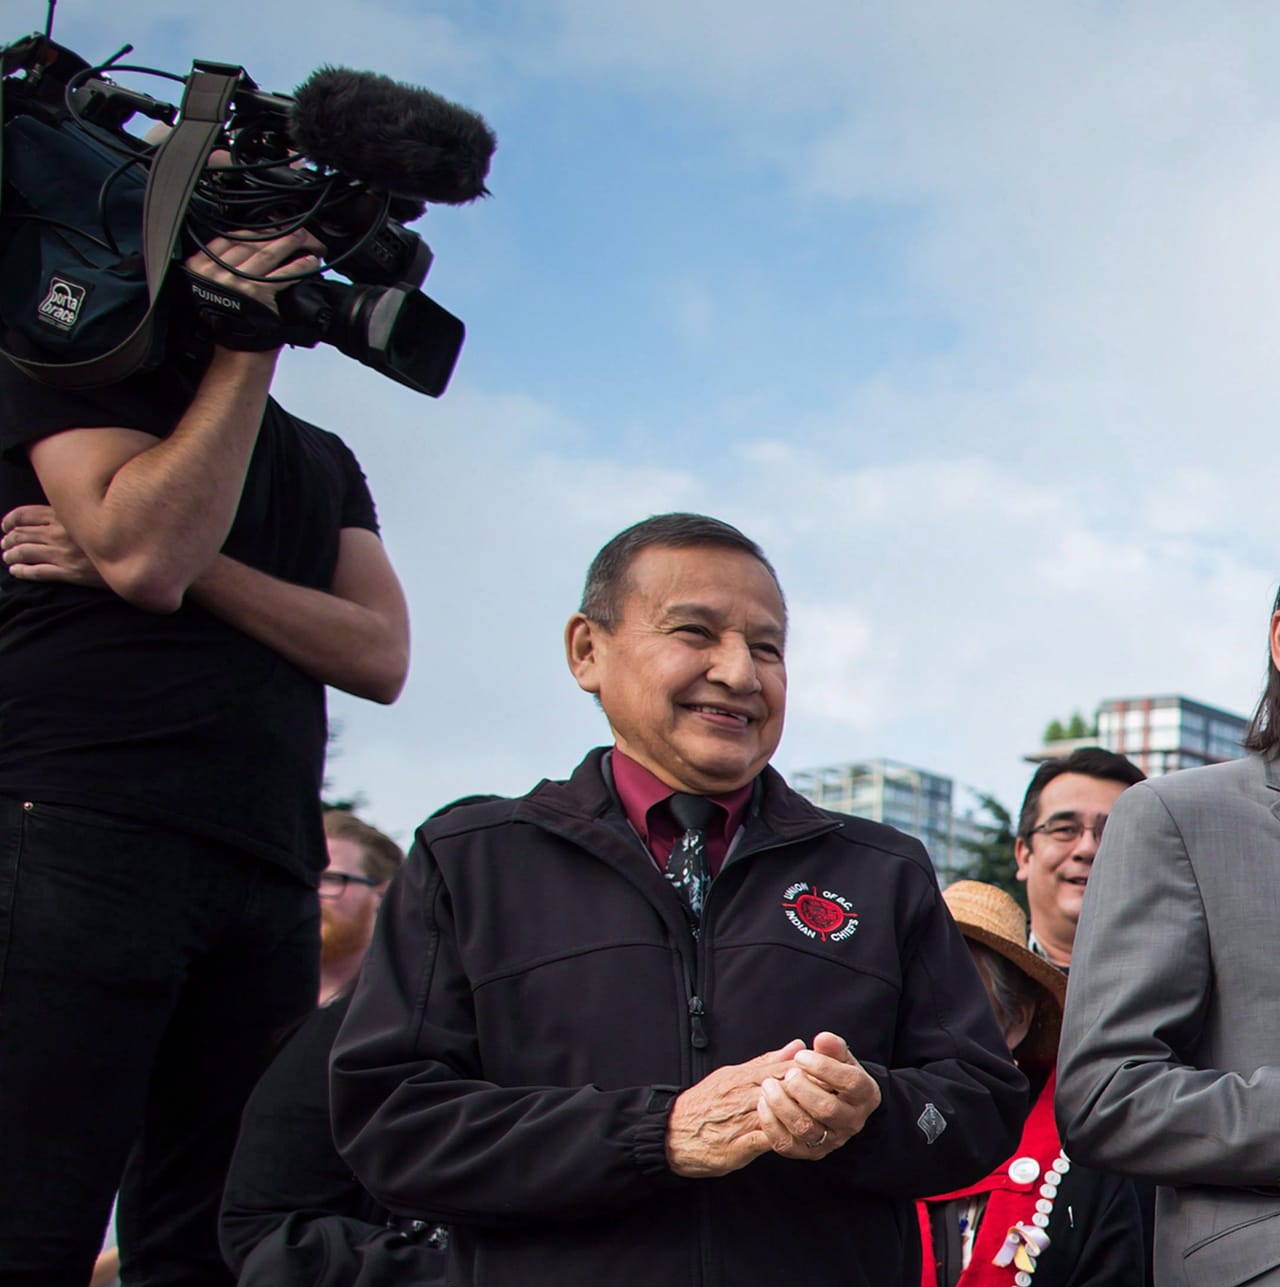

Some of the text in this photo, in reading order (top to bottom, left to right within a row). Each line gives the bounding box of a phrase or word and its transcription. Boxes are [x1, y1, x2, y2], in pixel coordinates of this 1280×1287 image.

[49, 291, 78, 310] porta
[192, 285, 241, 310] FUJINON
[41, 302, 75, 323] brace
[783, 882, 809, 900] UNION
[822, 890, 838, 899] OF
[785, 910, 859, 942] INDIAN CHIEFS
